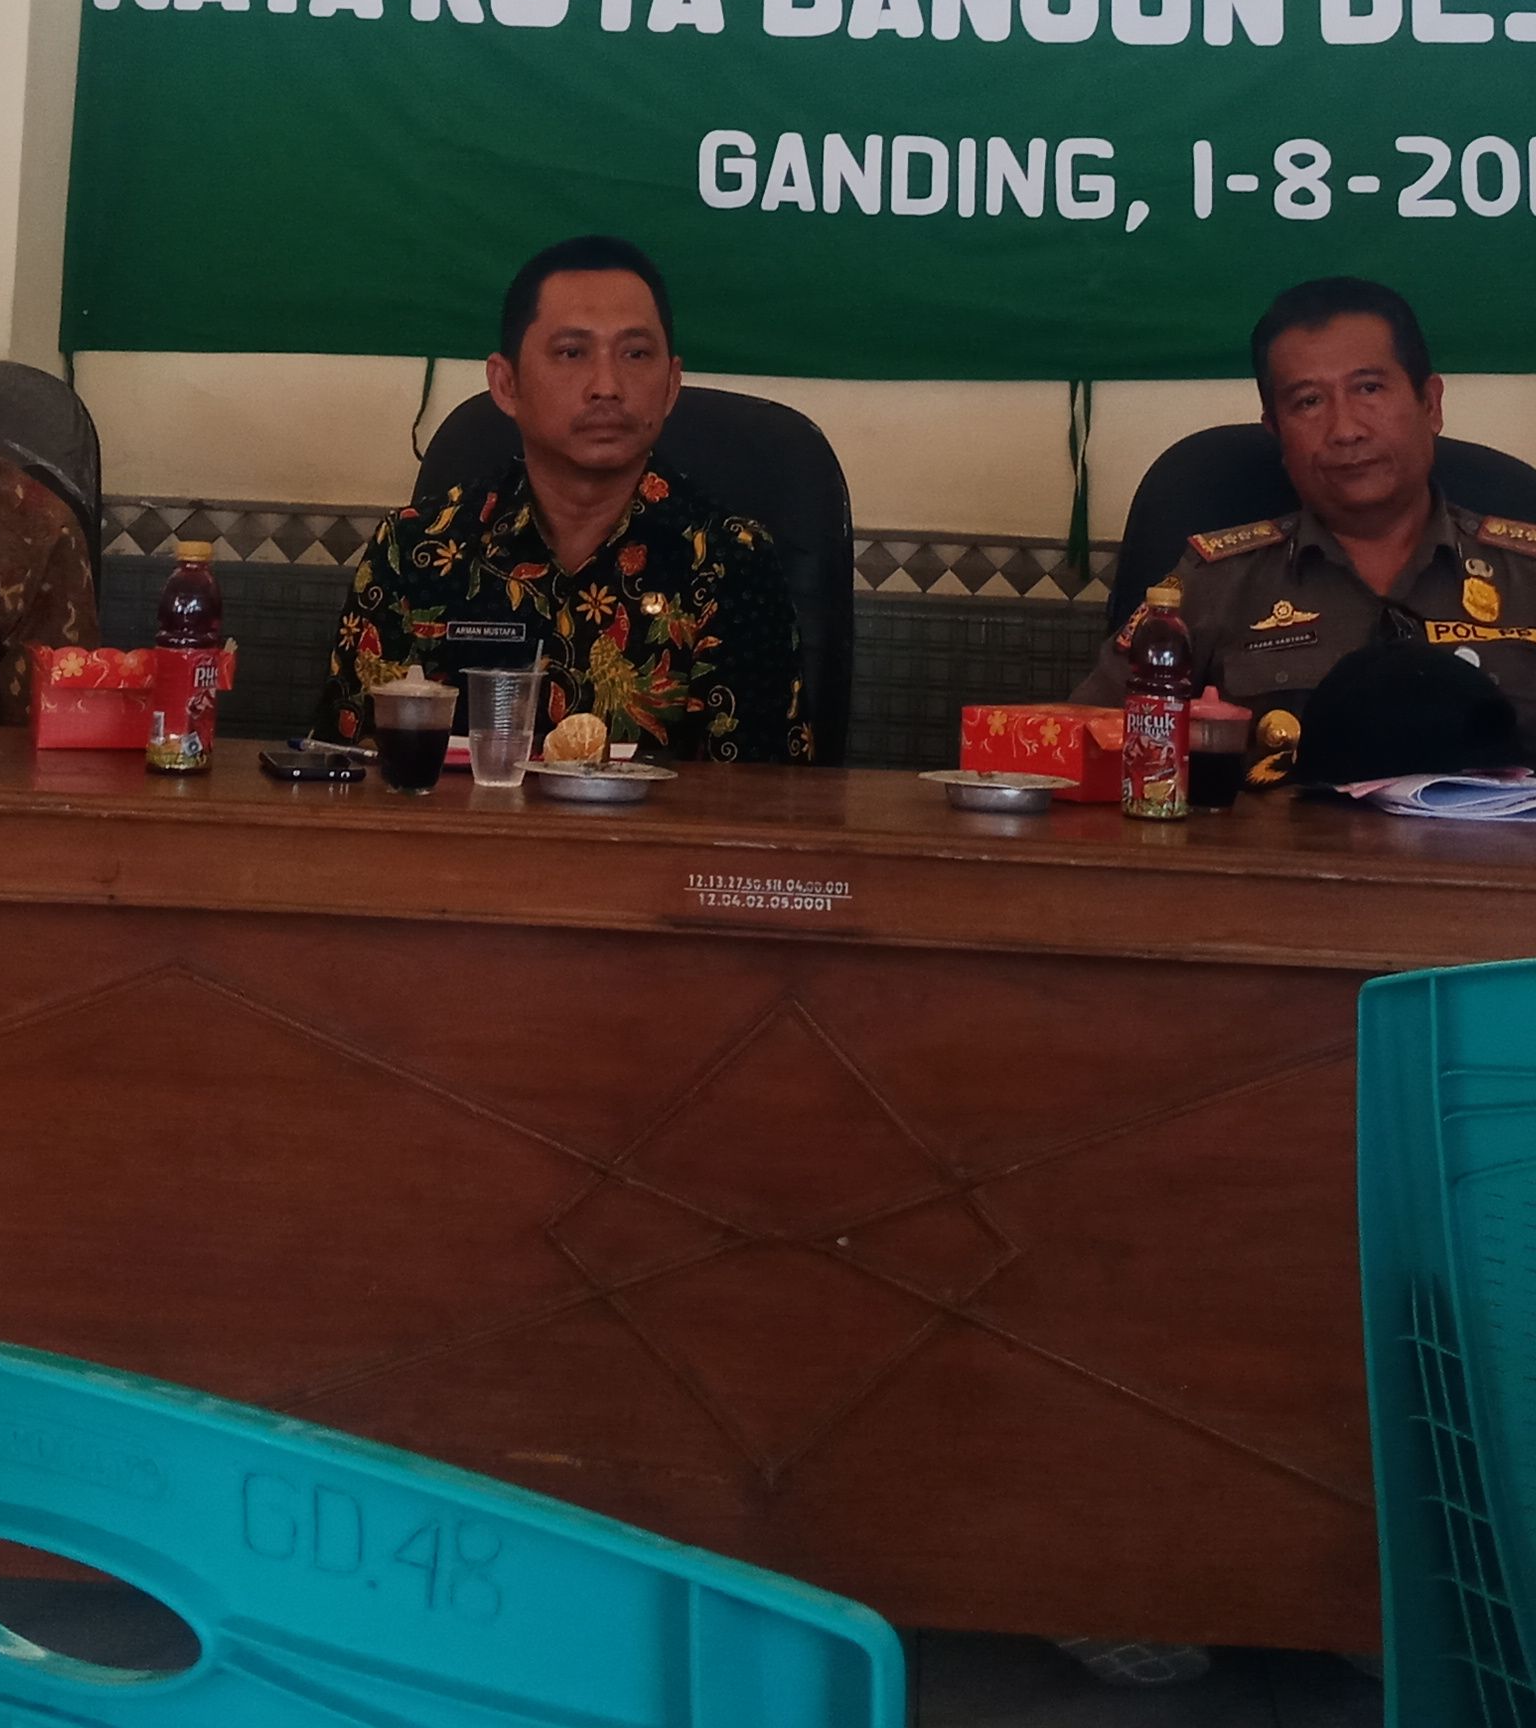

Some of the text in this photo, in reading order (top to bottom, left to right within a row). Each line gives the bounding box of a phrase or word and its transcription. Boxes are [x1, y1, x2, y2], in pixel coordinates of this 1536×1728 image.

[697, 129, 1151, 233] GANDING,
[455, 626, 516, 636] ARMAN MUSTAFA
[1434, 623, 1487, 640] POL
